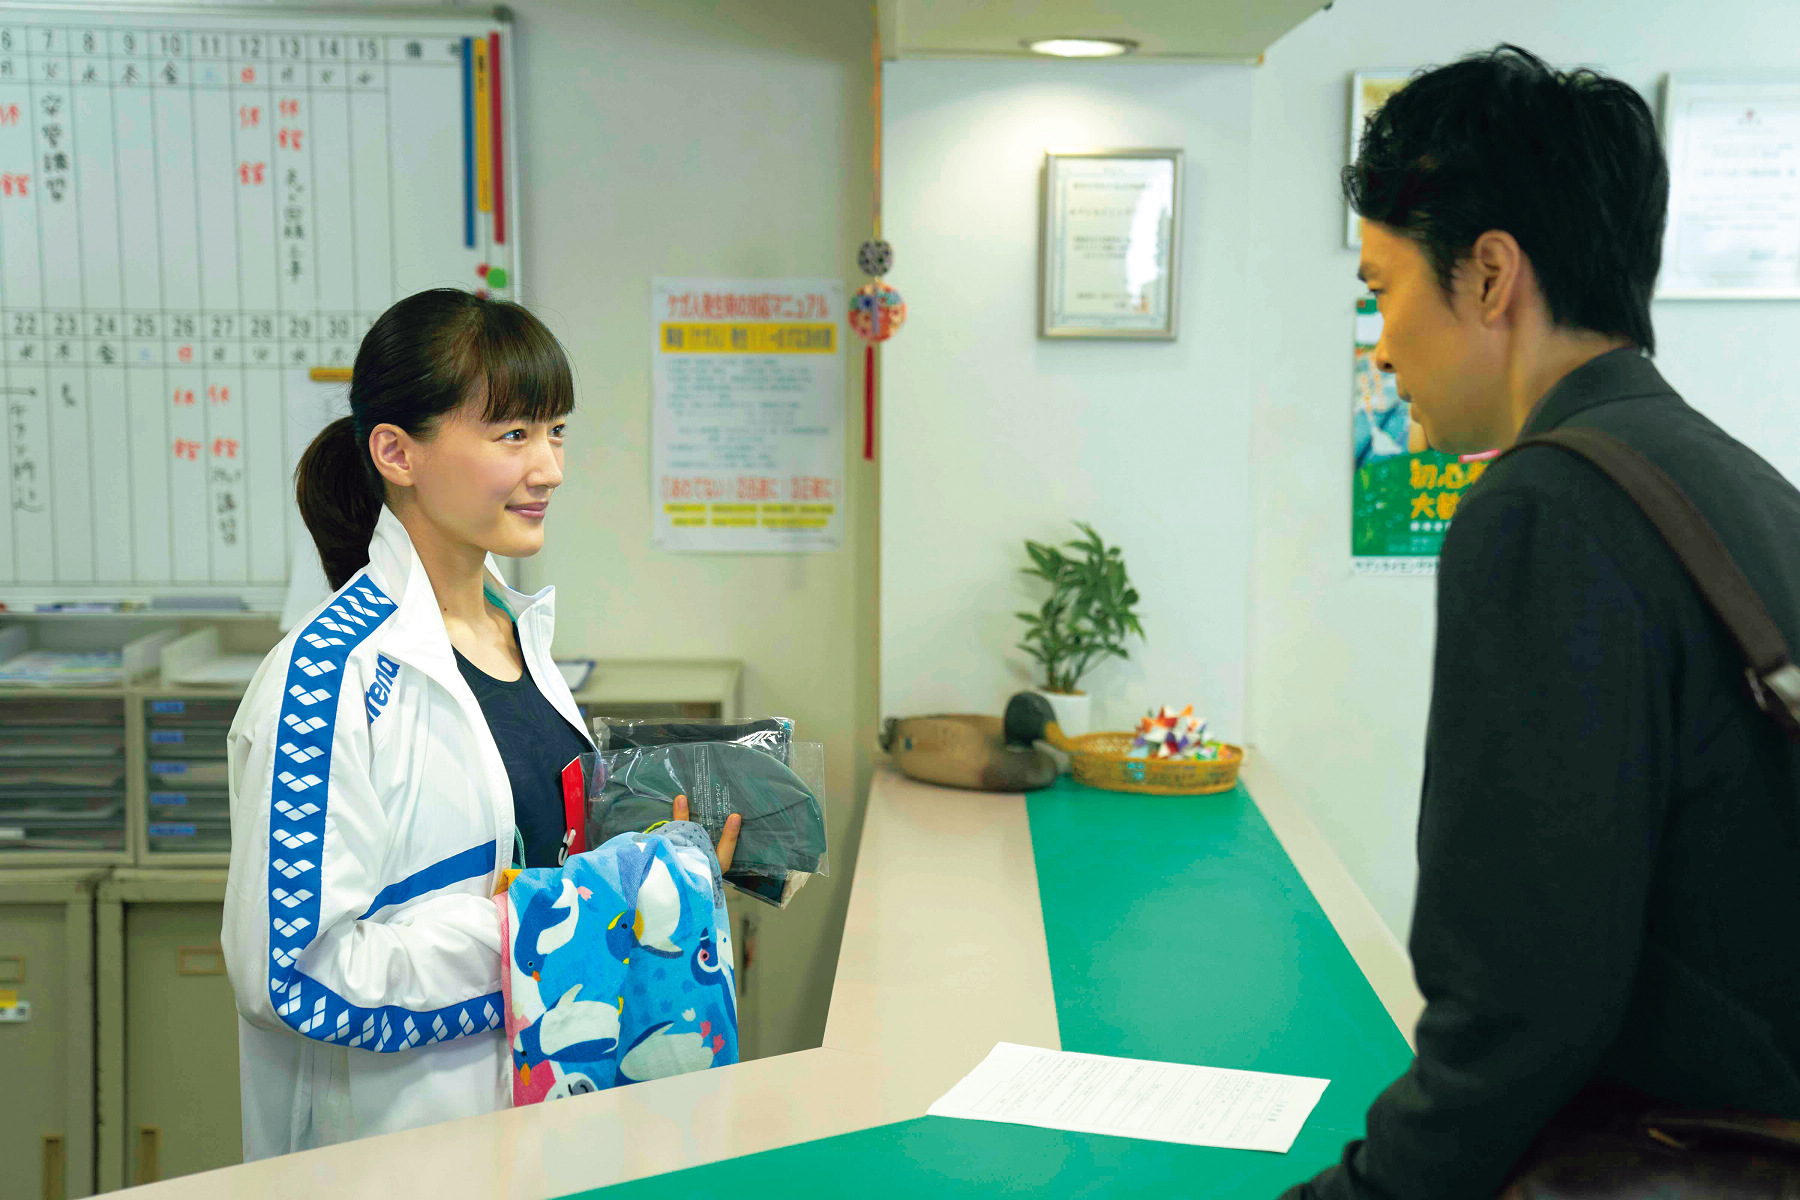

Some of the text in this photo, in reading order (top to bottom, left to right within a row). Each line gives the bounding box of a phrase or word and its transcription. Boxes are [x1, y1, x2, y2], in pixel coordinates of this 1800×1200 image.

[42, 29, 53, 49] 7
[83, 33, 95, 54] 8
[123, 32, 136, 54] 9
[161, 33, 182, 57] 10
[201, 36, 220, 54] 11
[240, 36, 262, 57] 12
[279, 37, 300, 58] 13
[318, 38, 339, 58] 14
[357, 38, 378, 59] 15
[13, 315, 350, 340] 22 23 24 25 26 27 28 29 30
[366, 653, 400, 724] rena
